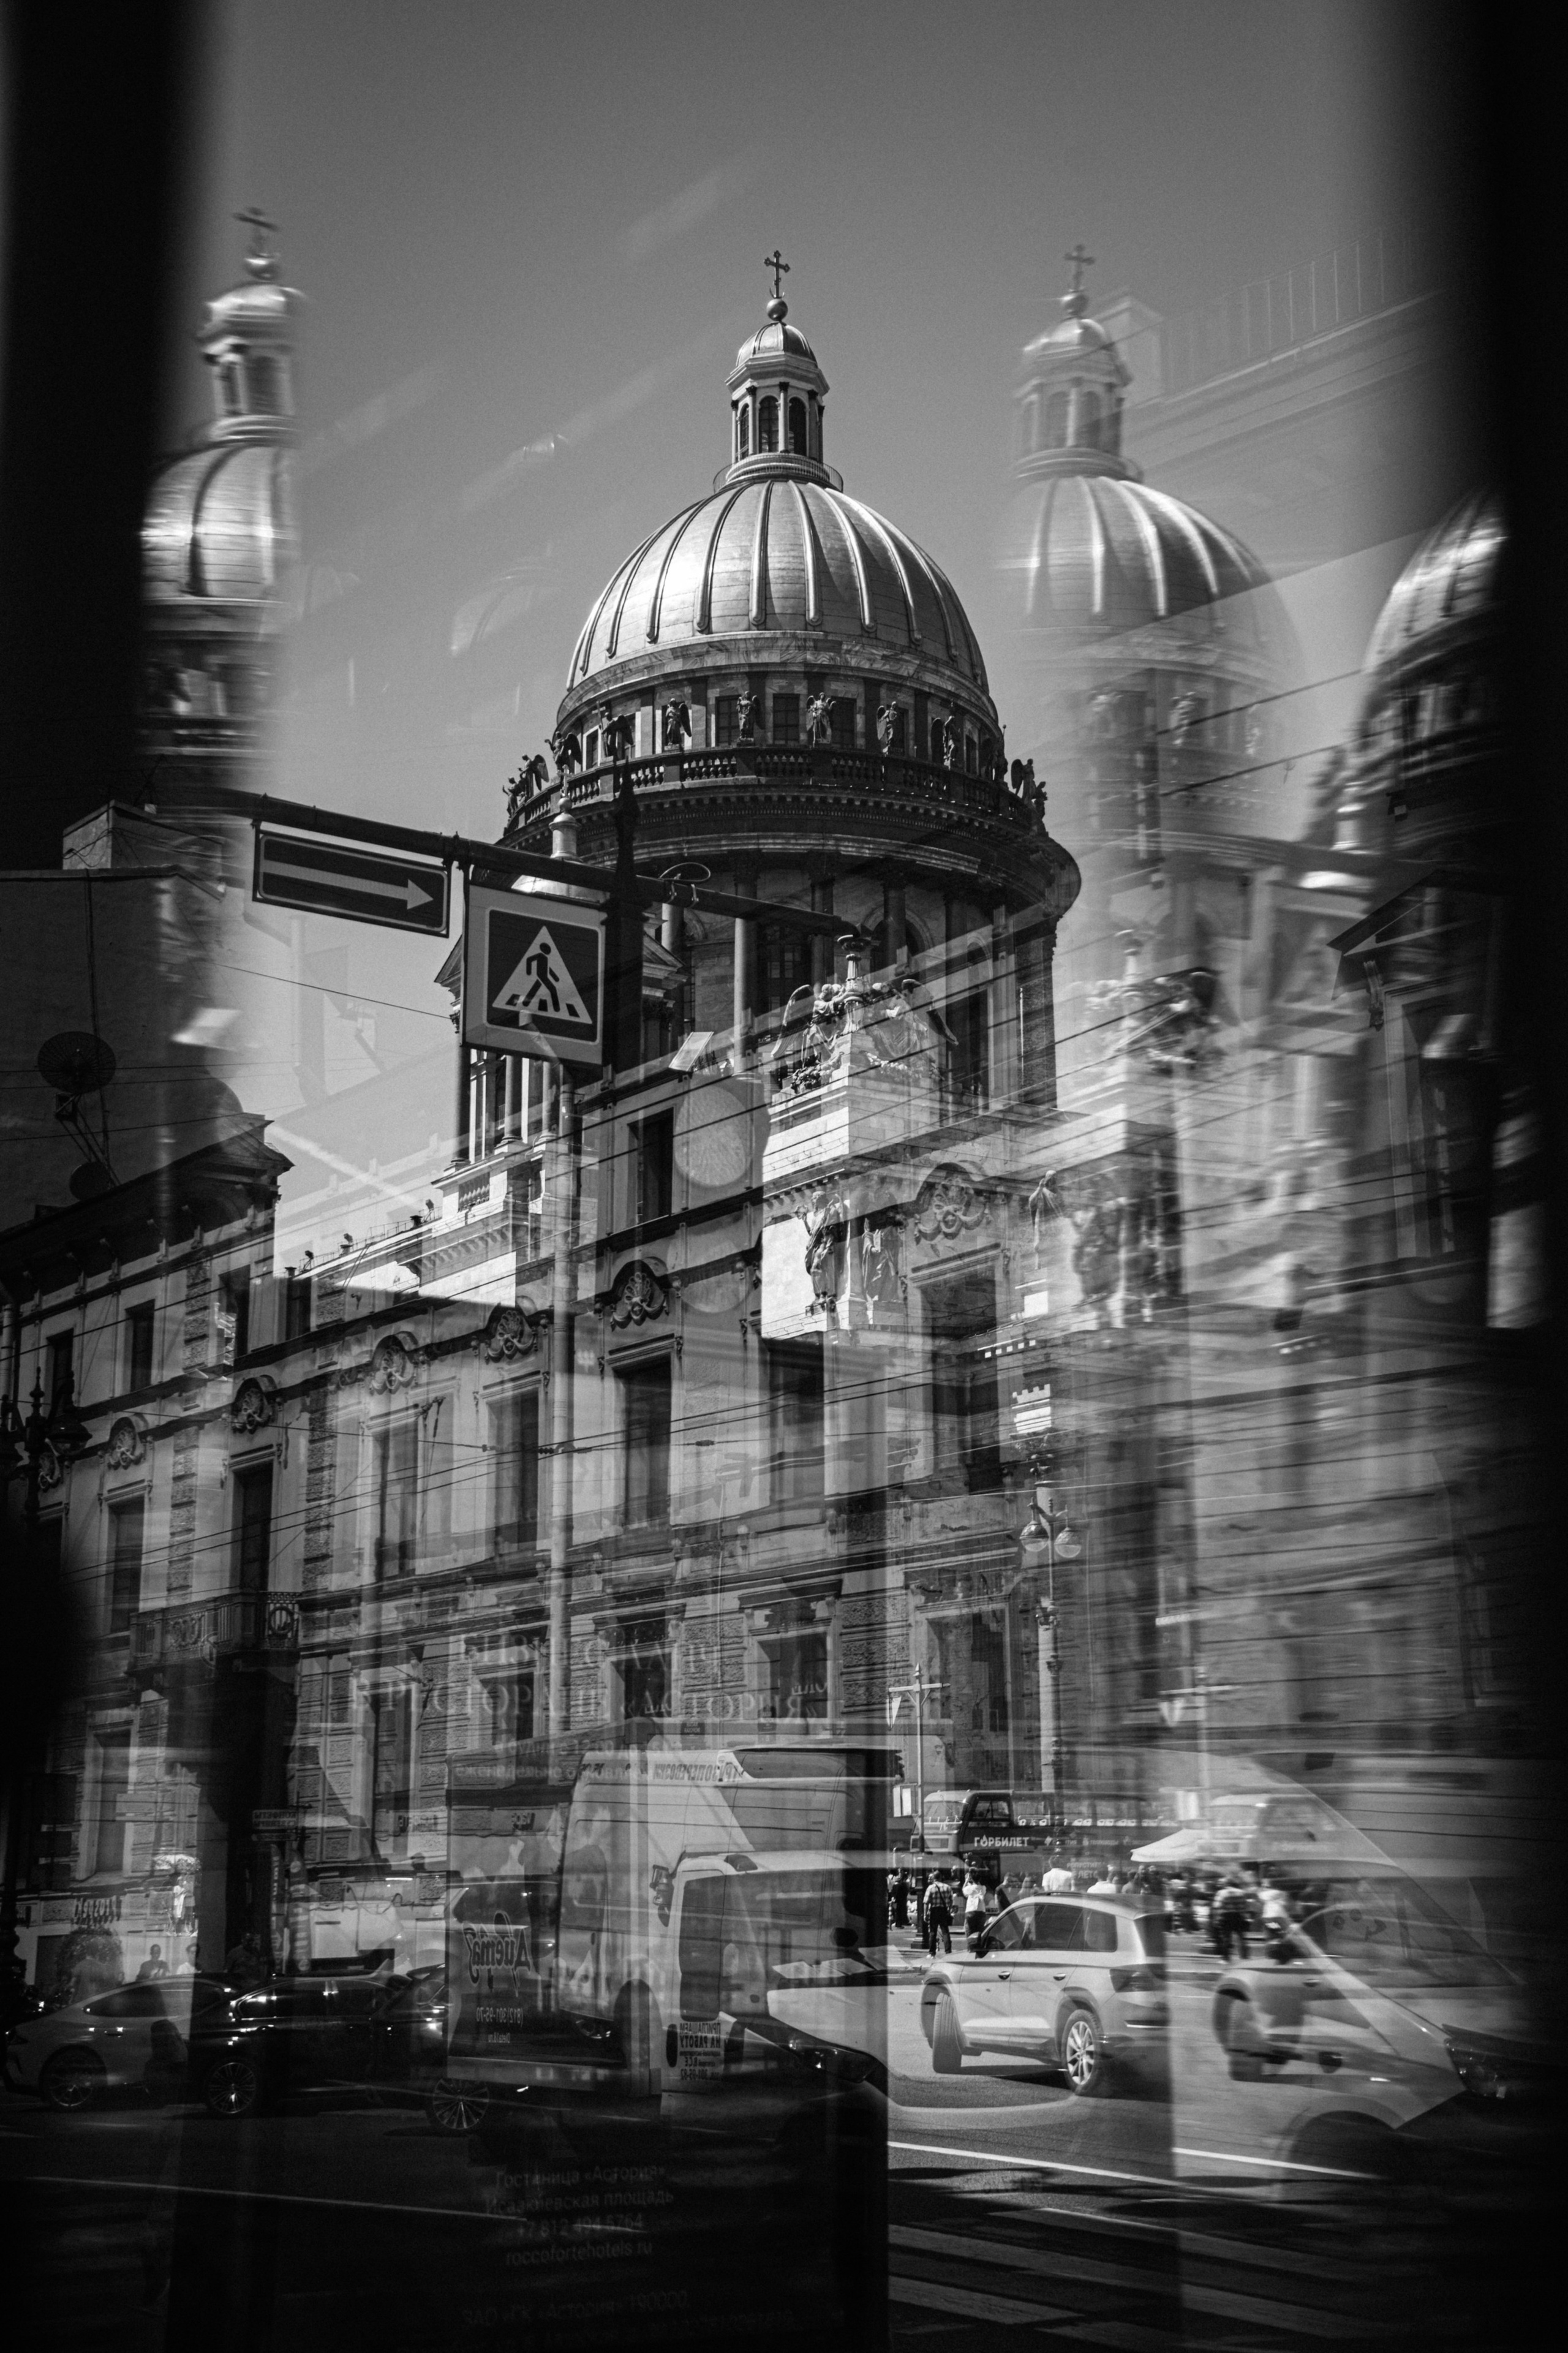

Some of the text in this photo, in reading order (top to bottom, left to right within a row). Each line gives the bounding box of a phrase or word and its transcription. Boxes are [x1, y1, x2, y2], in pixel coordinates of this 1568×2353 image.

[974, 1835, 1030, 1847] ГОРБИЛЕТ
[494, 2164, 666, 2189] Гостиница «Астория»
[603, 2189, 675, 2208] площадь
